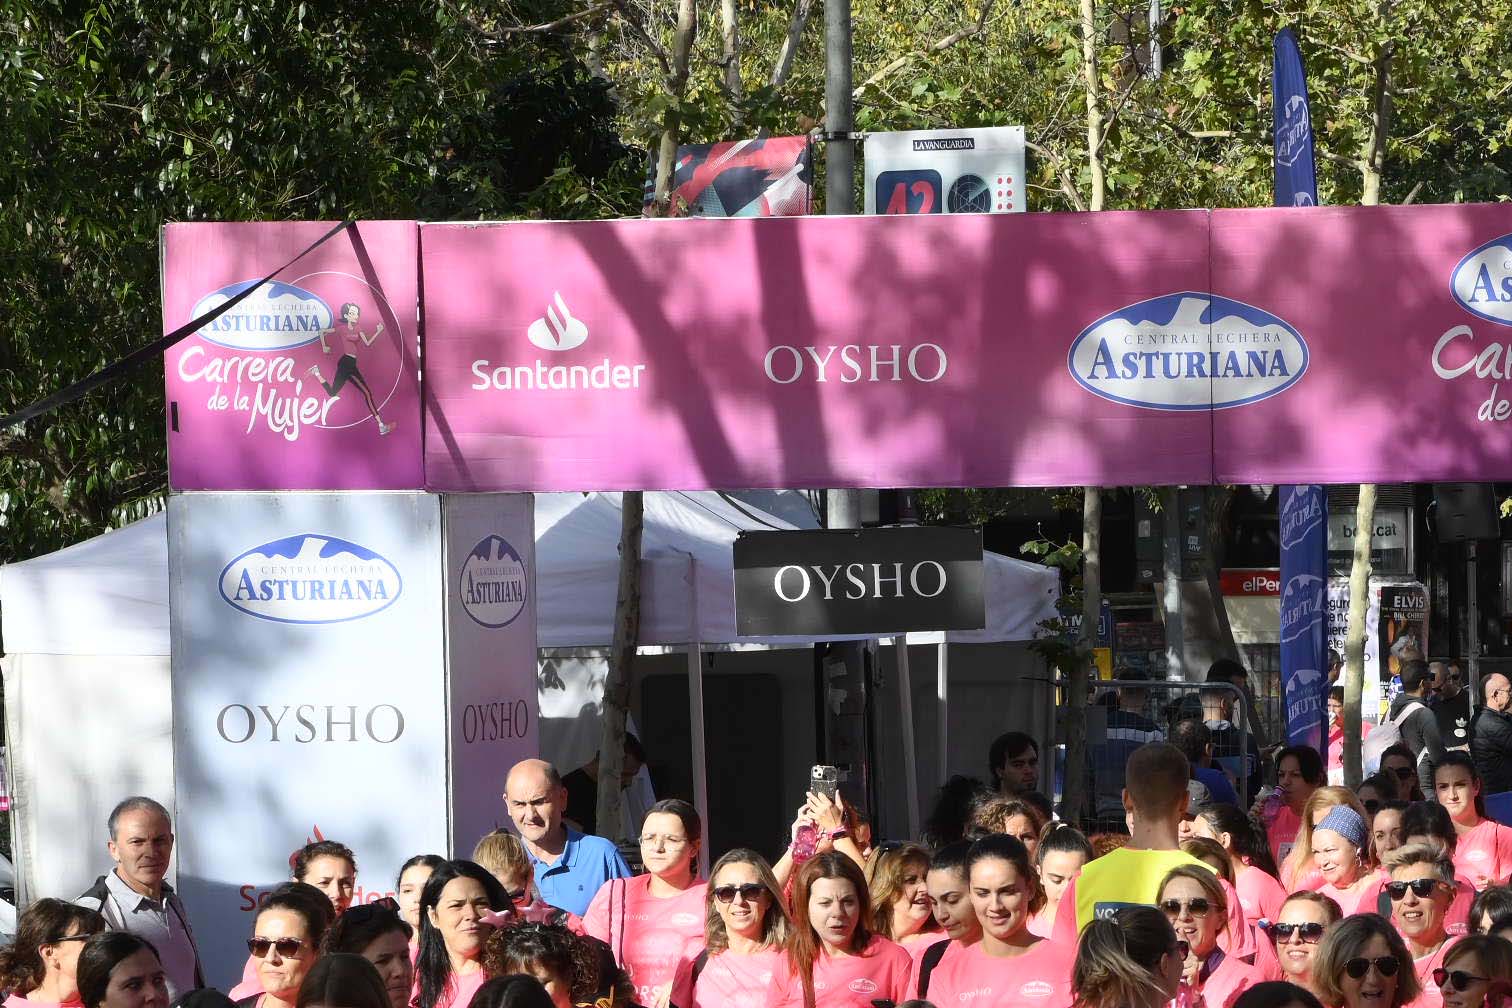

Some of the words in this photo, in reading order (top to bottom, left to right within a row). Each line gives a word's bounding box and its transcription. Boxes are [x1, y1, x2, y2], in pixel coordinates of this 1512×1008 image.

[1123, 332, 1200, 345] CENTRAL
[178, 346, 295, 383] Carrera
[471, 357, 646, 391] Santander
[764, 342, 948, 384] OYSHO
[1087, 336, 1290, 380] ASTURIANA
[207, 385, 229, 411] de
[234, 383, 249, 411] la
[247, 379, 340, 441] Mujer
[1477, 379, 1510, 422] de
[233, 568, 389, 601] ASTURIANA
[261, 565, 318, 575] CENTRAL
[464, 573, 523, 604] ASTURIANA
[774, 560, 947, 602] OYSHO
[1243, 576, 1280, 592] elPer
[1394, 596, 1424, 608] ELVIS
[216, 703, 405, 744] OYSHO
[462, 700, 529, 744] OYSHO
